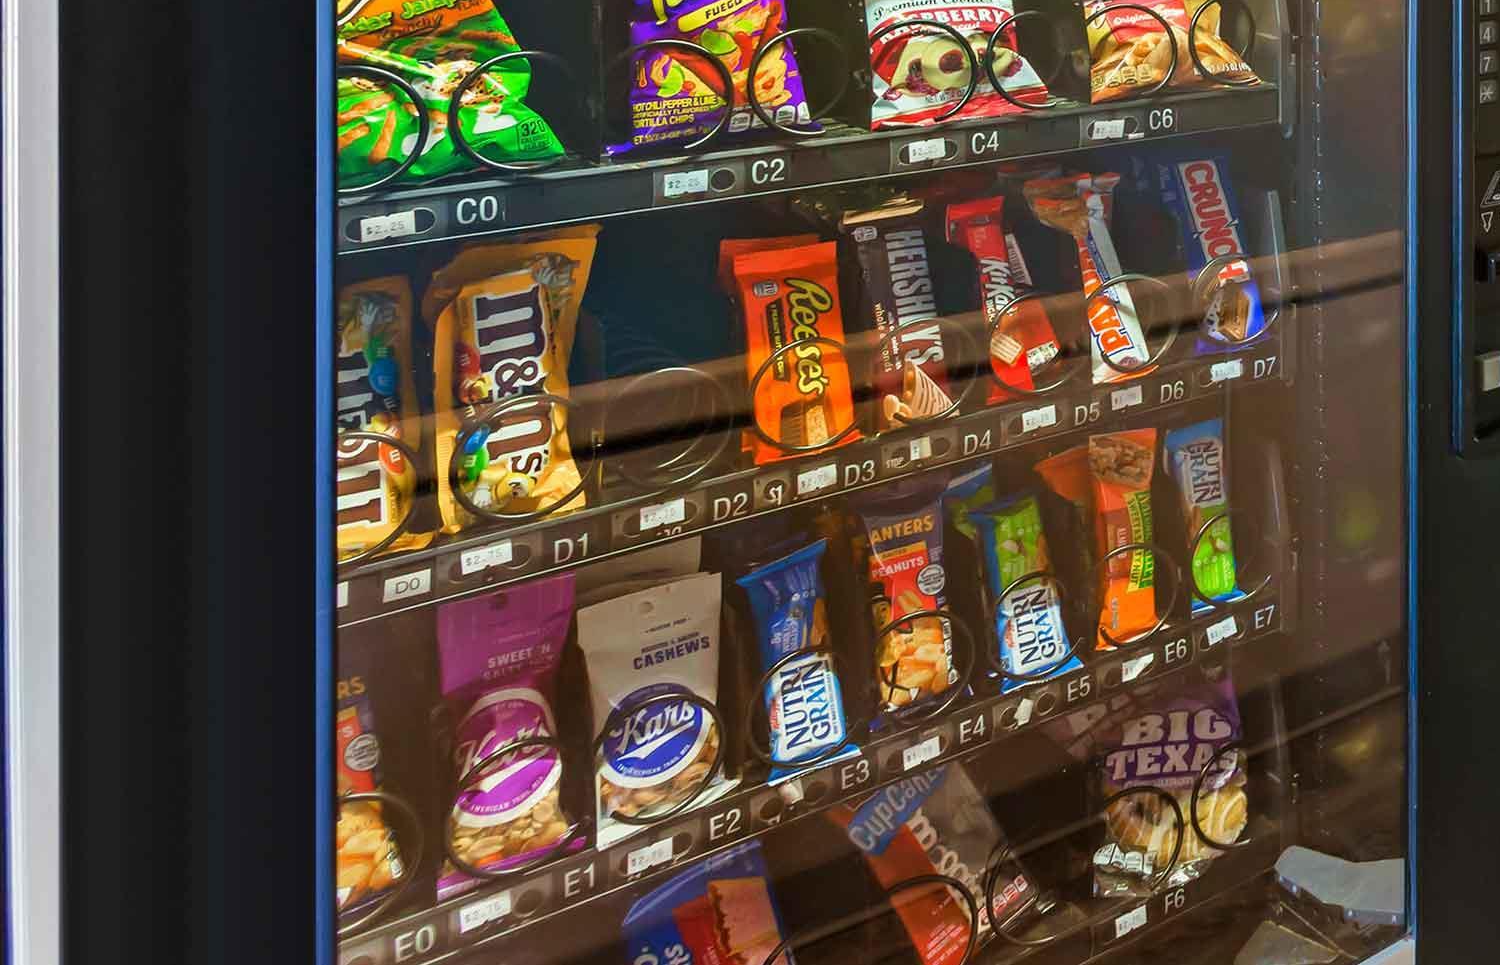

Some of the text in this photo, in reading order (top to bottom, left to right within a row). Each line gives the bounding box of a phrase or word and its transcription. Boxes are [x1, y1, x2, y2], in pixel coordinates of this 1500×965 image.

[1112, 12, 1155, 26] Origina
[662, 97, 693, 109] PEPPER
[520, 120, 545, 137] 320
[1149, 108, 1174, 130] C6
[971, 130, 1000, 155] C4
[751, 158, 785, 185] C2
[456, 195, 498, 225] C0
[1184, 159, 1249, 283] CRUNCH
[783, 277, 833, 396] Reese's
[880, 332, 892, 373] aonds
[1254, 356, 1277, 378] D7
[1160, 380, 1185, 404] D6
[1074, 402, 1100, 426] D5
[963, 428, 992, 456] D4
[844, 459, 875, 486] D3
[713, 492, 749, 522] D2
[870, 514, 935, 543] ANTERS
[554, 531, 590, 564] D1
[871, 555, 925, 578] PEANUTS
[395, 577, 421, 594] D0
[1011, 588, 1041, 667] NUTRI
[1031, 587, 1057, 659] GRAIN
[1254, 605, 1275, 629] E7
[488, 647, 534, 670] SWEET
[633, 635, 711, 671] CASHEWS
[1164, 638, 1188, 664] E6
[808, 660, 832, 740] GRAIN
[1066, 675, 1091, 702] E5
[785, 667, 808, 750] NUTRI
[959, 713, 986, 745] E4
[1121, 707, 1232, 747] BIG
[840, 759, 871, 791] E3
[1106, 740, 1240, 781] TEXAS
[708, 809, 742, 840] E2
[563, 863, 598, 897] E1
[1164, 892, 1185, 914] F6
[393, 926, 435, 963] E0
